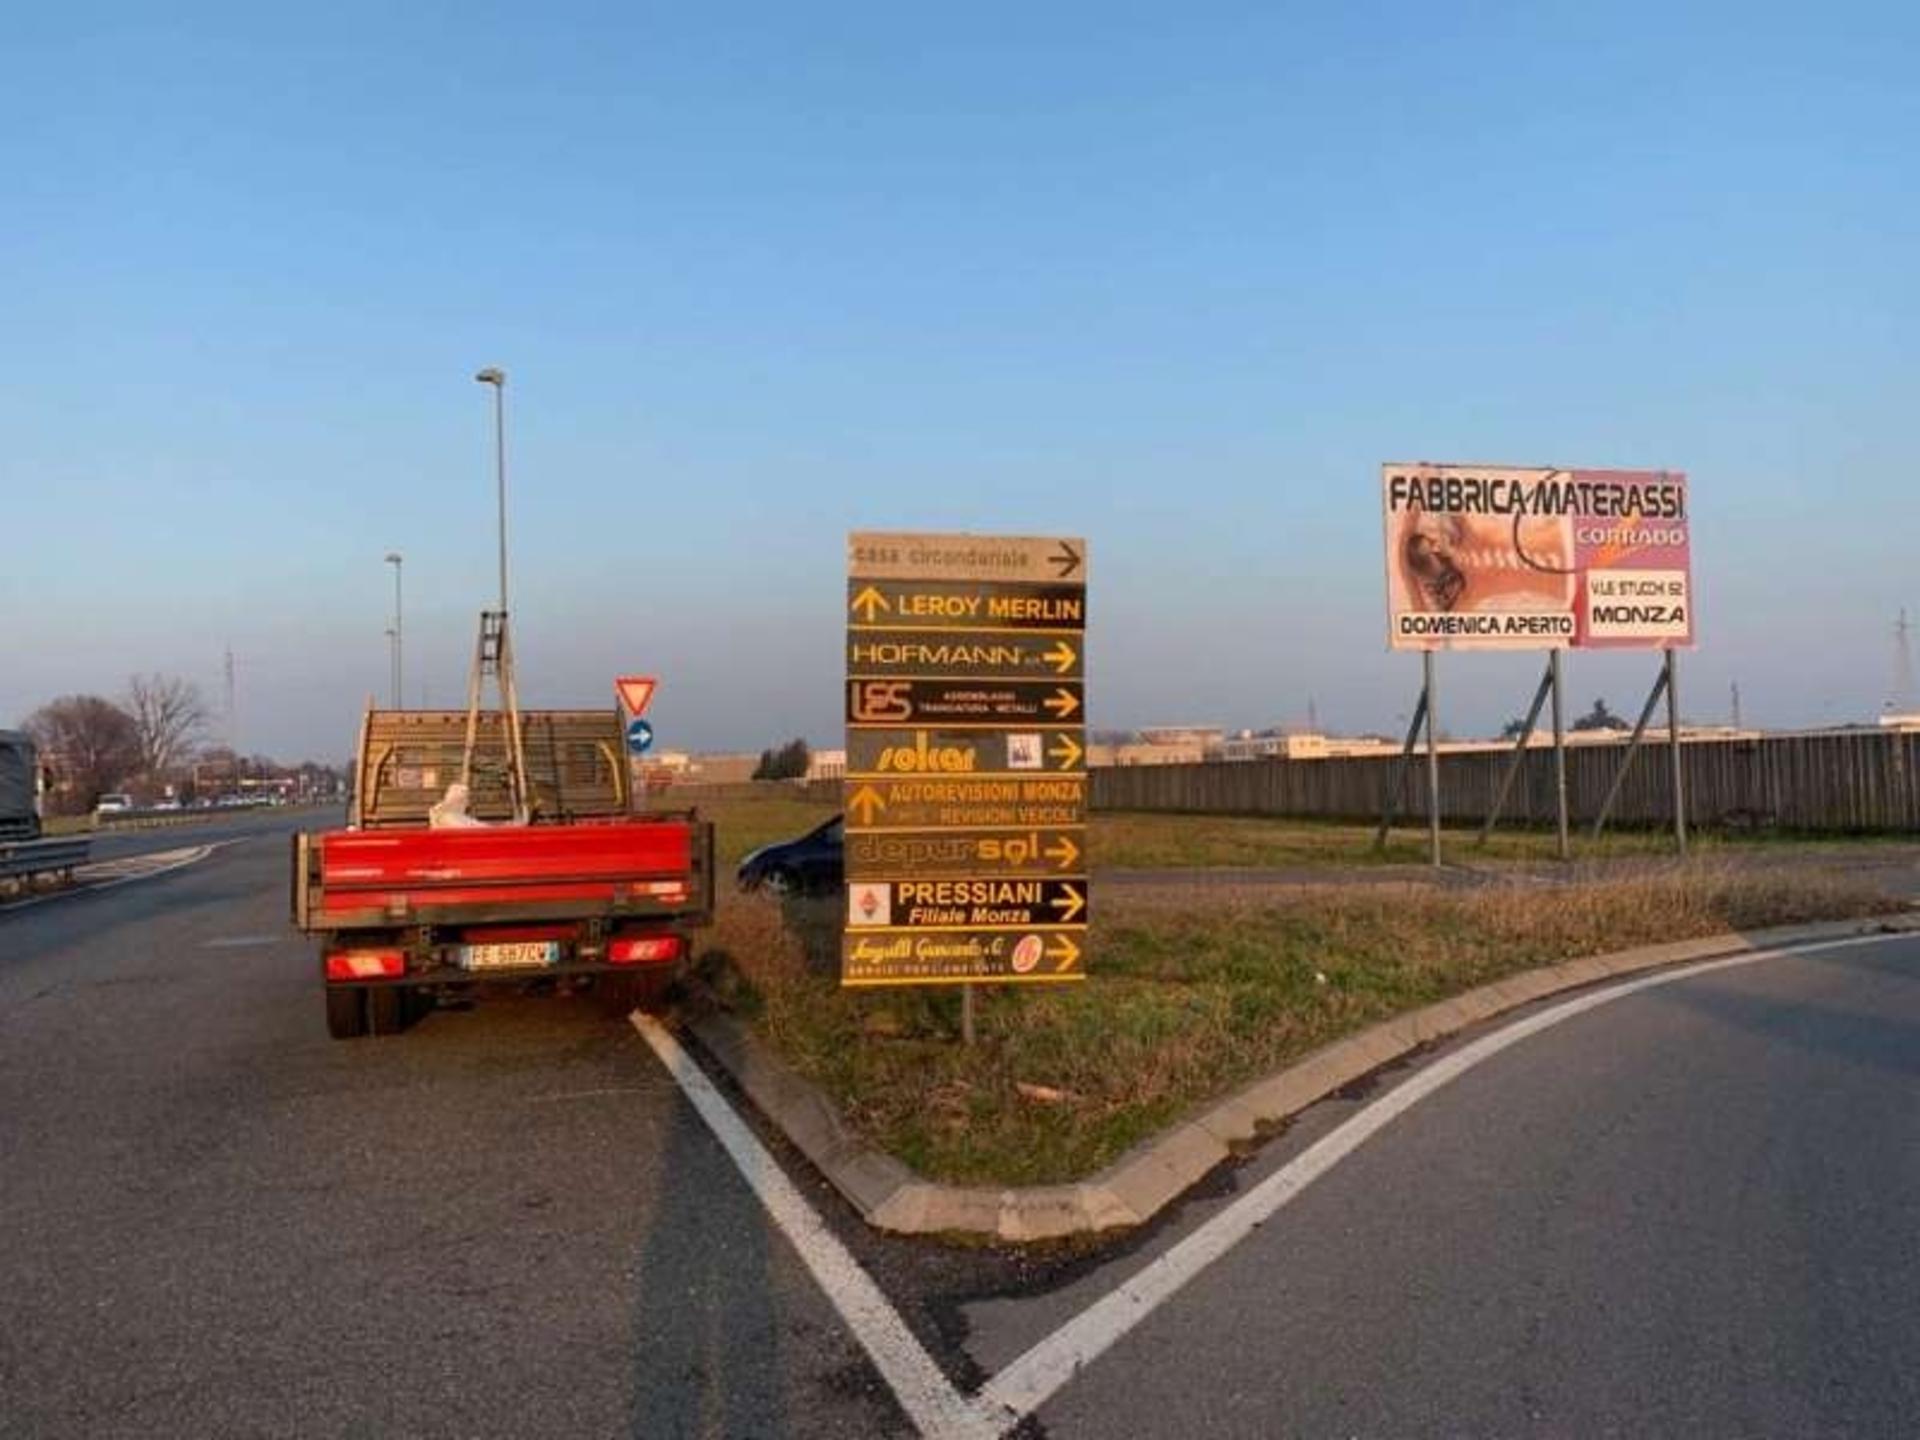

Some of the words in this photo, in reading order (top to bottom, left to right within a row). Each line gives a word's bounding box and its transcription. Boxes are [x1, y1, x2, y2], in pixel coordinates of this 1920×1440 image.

[1390, 476, 1527, 514] FABBRICA
[1532, 480, 1684, 518] MATERASSI
[1577, 527, 1685, 545] CORRADO
[899, 595, 980, 617] LEROY
[988, 597, 1080, 620] MERLIN
[1592, 606, 1685, 624] MONZA
[1401, 616, 1500, 635] DOMENICA
[1505, 616, 1572, 635] APERTO
[853, 644, 1020, 666] HOFMANN
[889, 782, 1020, 804] AUTOREVISIONI
[1023, 781, 1083, 802] MONZA
[899, 882, 1042, 904] PRESSIANI
[908, 907, 966, 925] Filiale
[971, 907, 1031, 924] Monza
